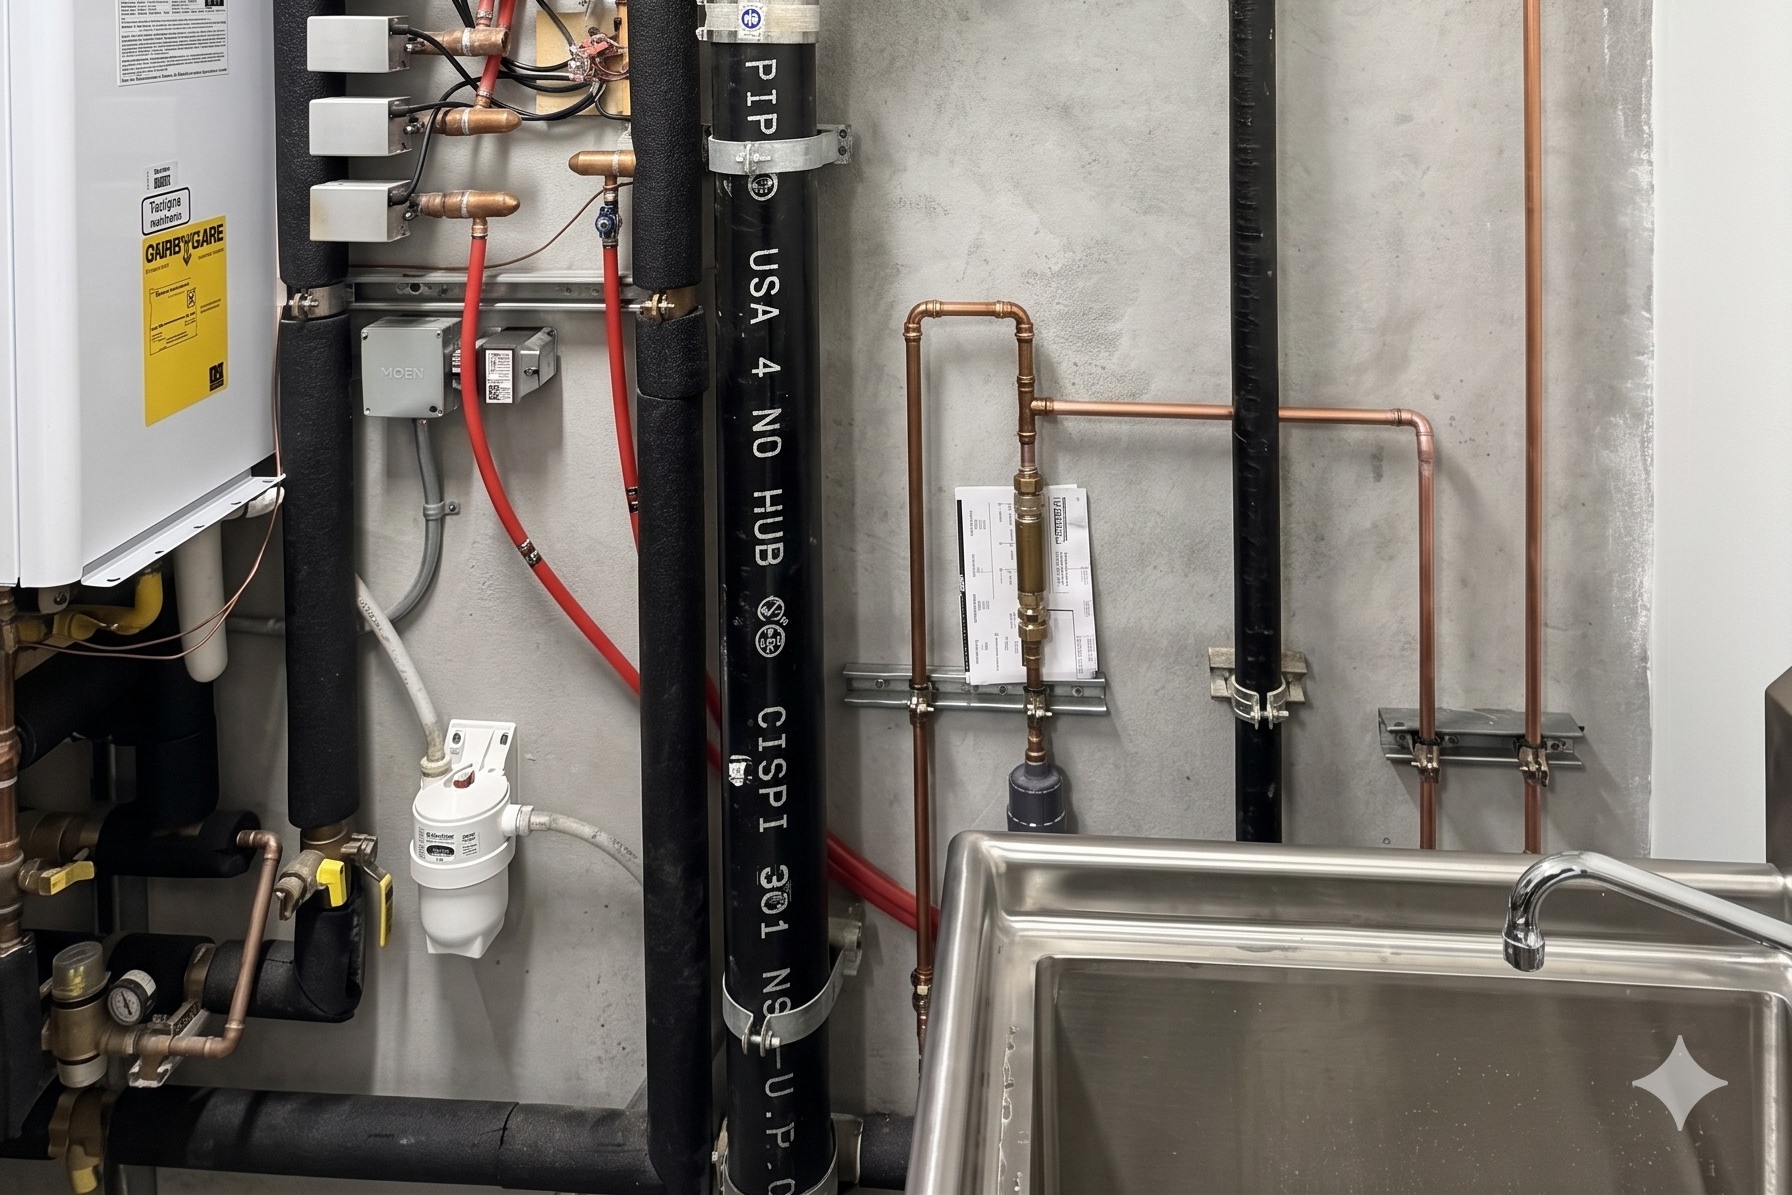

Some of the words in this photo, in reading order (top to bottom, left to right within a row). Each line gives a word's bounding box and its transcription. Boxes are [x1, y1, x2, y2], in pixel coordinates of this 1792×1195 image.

[745, 58, 777, 135] PIP
[750, 249, 779, 324] USA
[381, 367, 424, 379] MOEN
[752, 357, 780, 378] 4
[753, 408, 782, 458] NO
[754, 488, 784, 566] HUB
[758, 706, 787, 833] CISPI
[760, 864, 789, 939] 301
